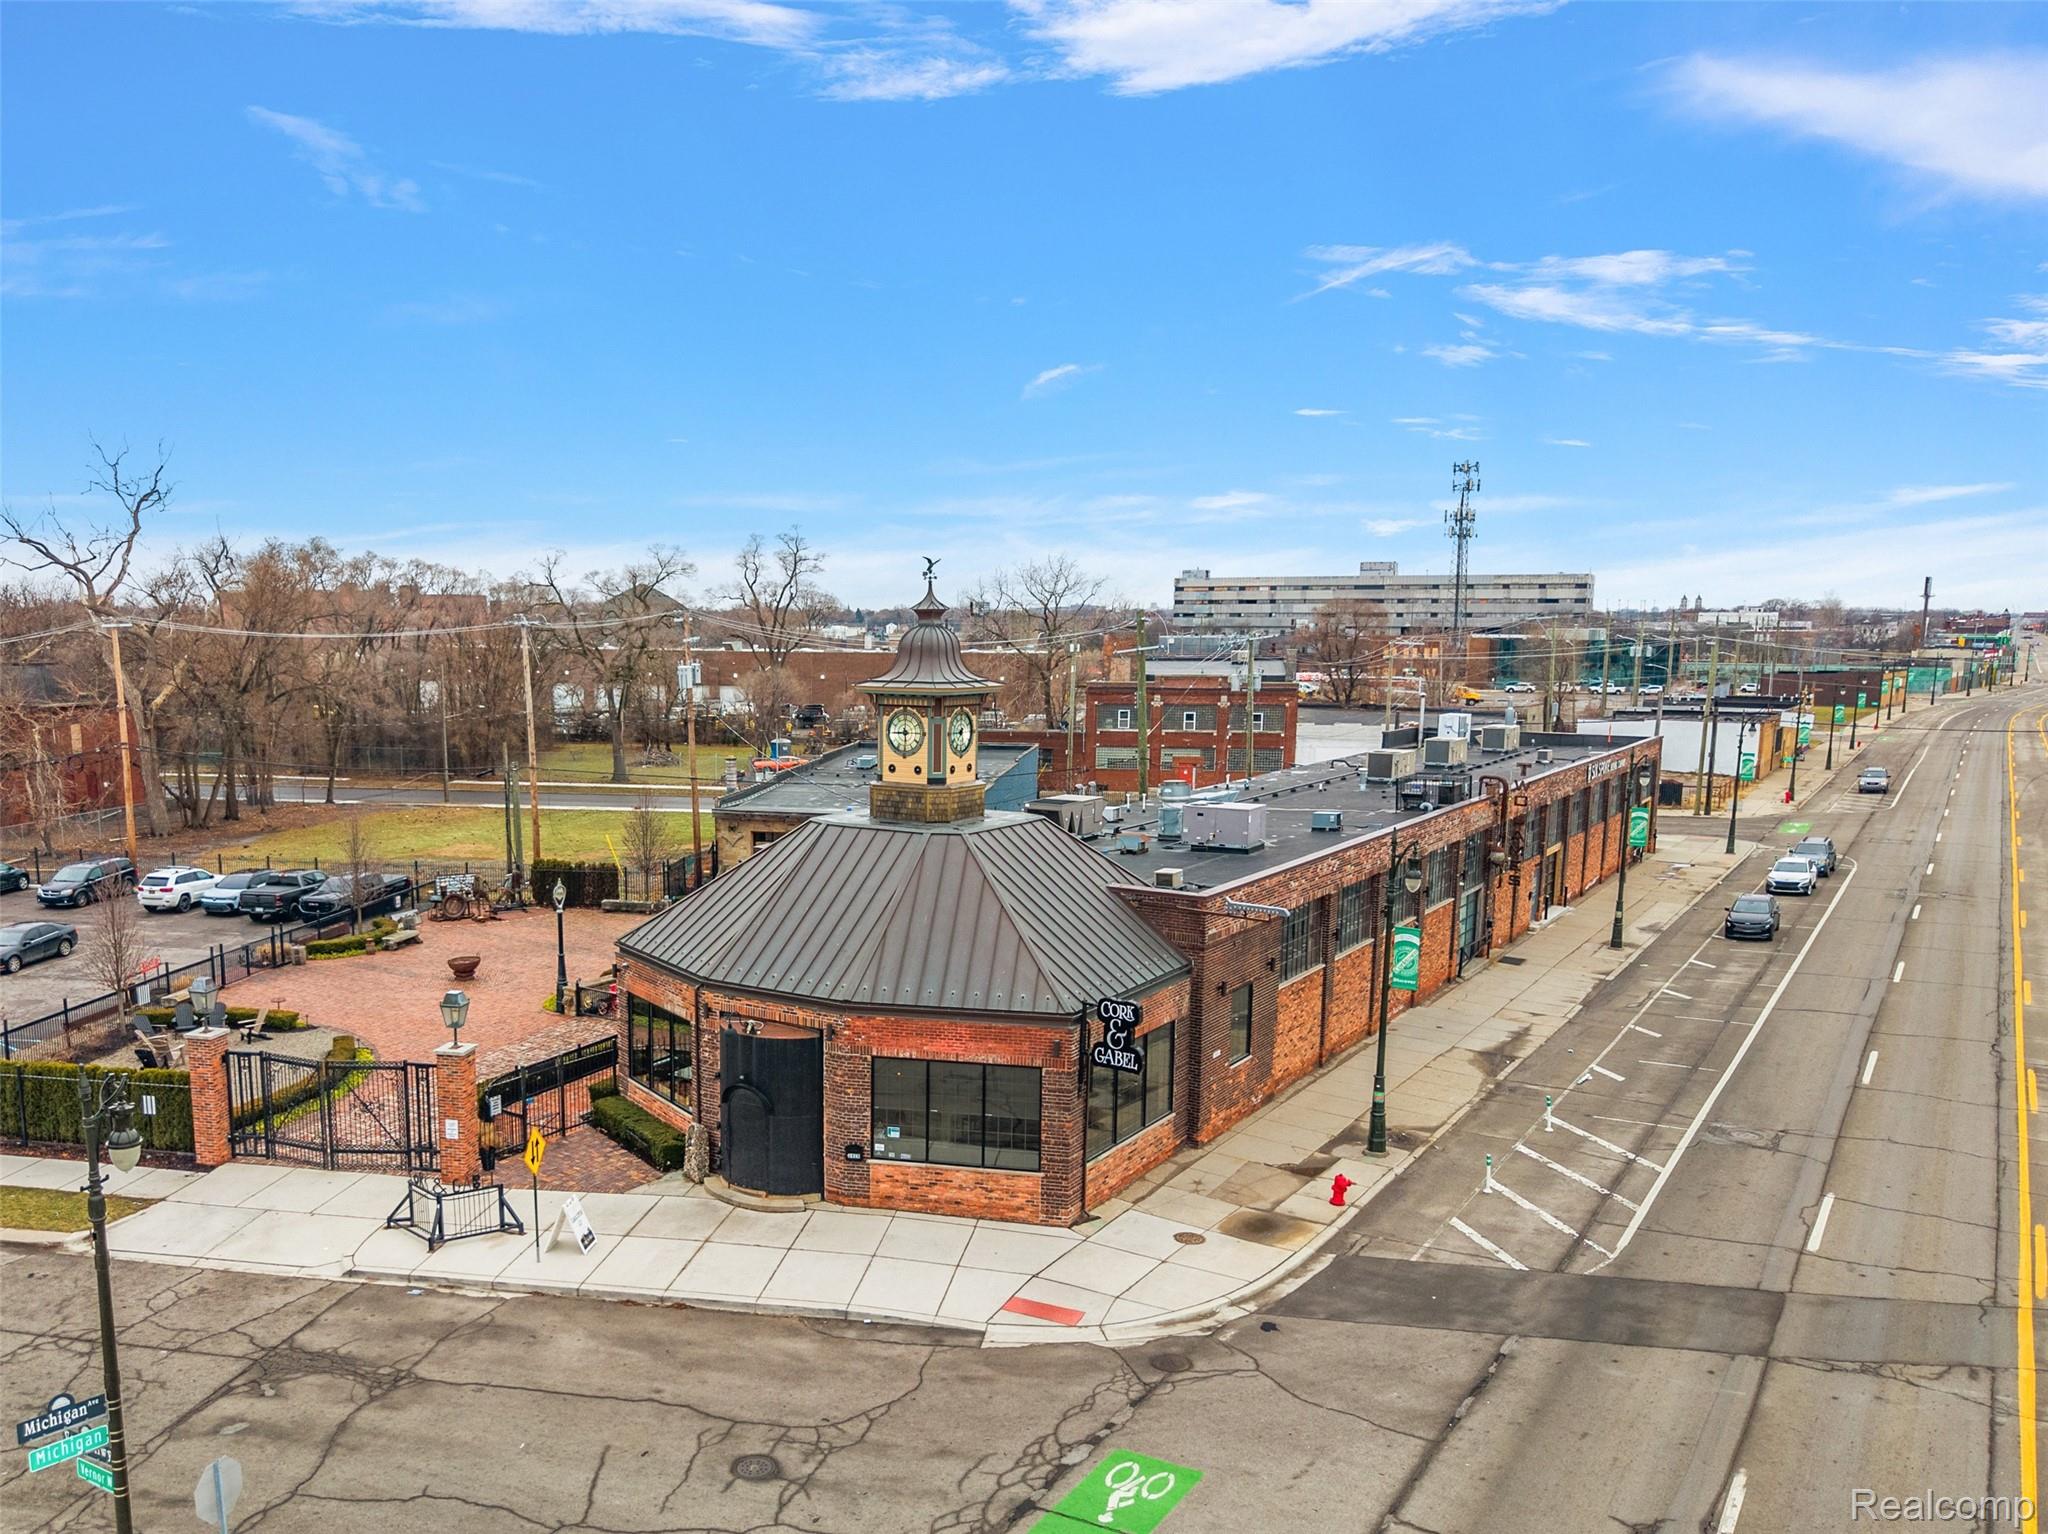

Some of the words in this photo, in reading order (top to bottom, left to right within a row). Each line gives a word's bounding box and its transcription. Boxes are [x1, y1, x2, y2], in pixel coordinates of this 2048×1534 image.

[1100, 1001, 1136, 1022] CORK
[1106, 1018, 1128, 1050] &
[1094, 1047, 1139, 1071] GABEL
[24, 1405, 88, 1437] Michigan
[87, 1398, 100, 1407] Ave
[35, 1431, 102, 1465] Michigan
[80, 1463, 105, 1485] Vernor
